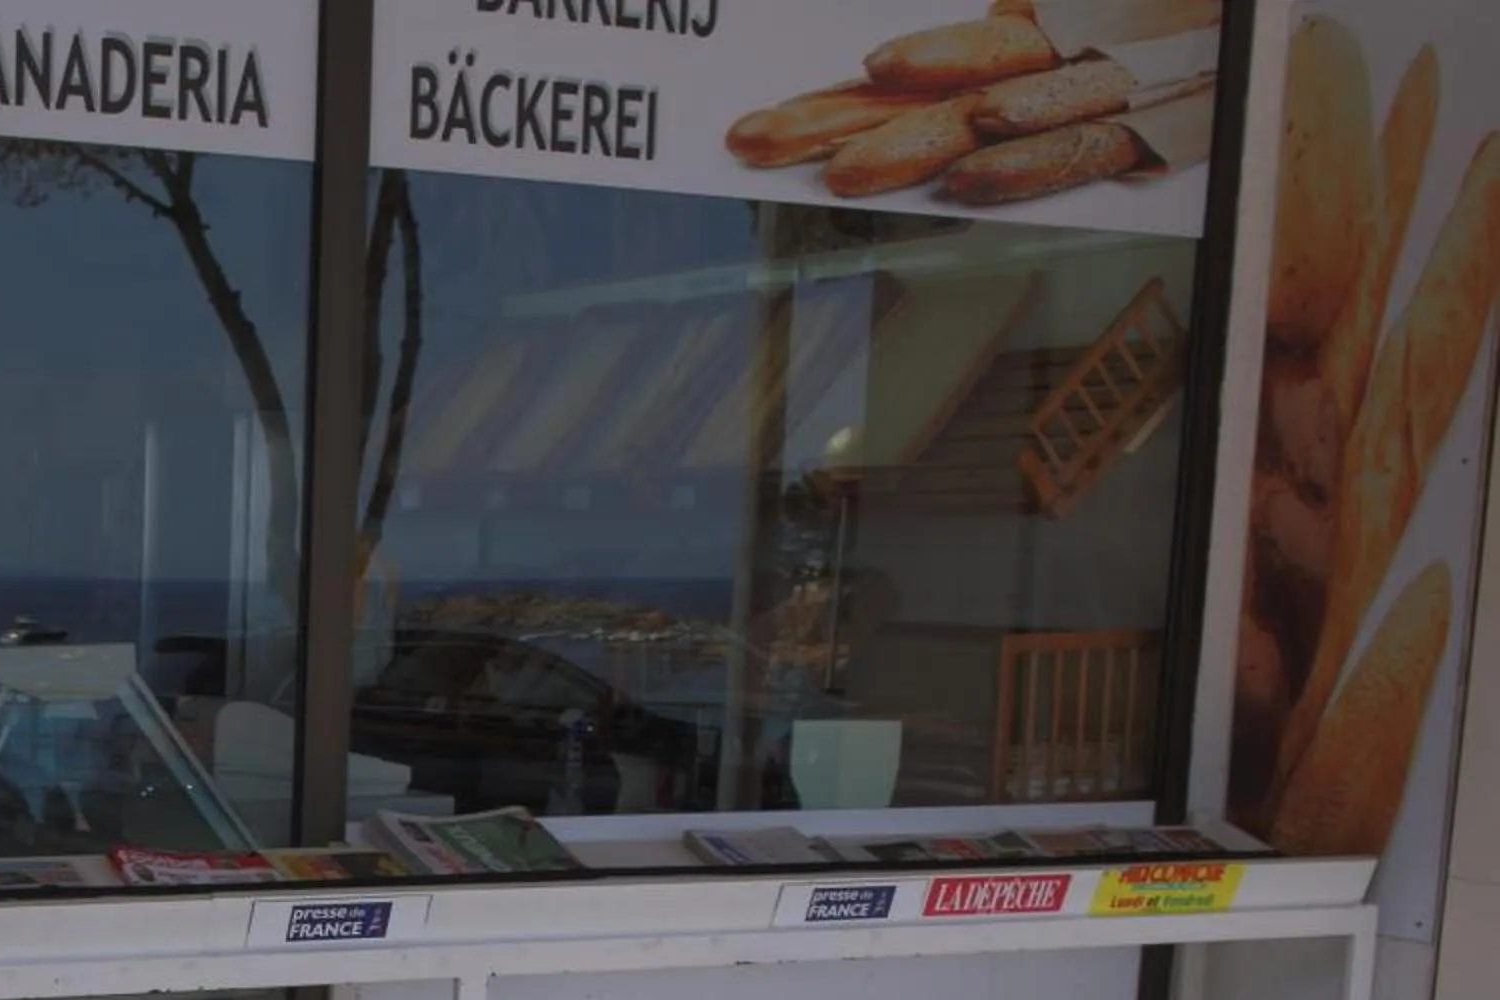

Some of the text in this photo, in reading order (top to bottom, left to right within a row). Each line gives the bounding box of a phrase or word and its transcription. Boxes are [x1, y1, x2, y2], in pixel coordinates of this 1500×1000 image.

[408, 48, 659, 160] BÄCKEREI
[812, 888, 859, 904] presse
[291, 904, 348, 924] presse
[807, 901, 871, 919] FRANCE
[288, 920, 364, 941] FRANCE
